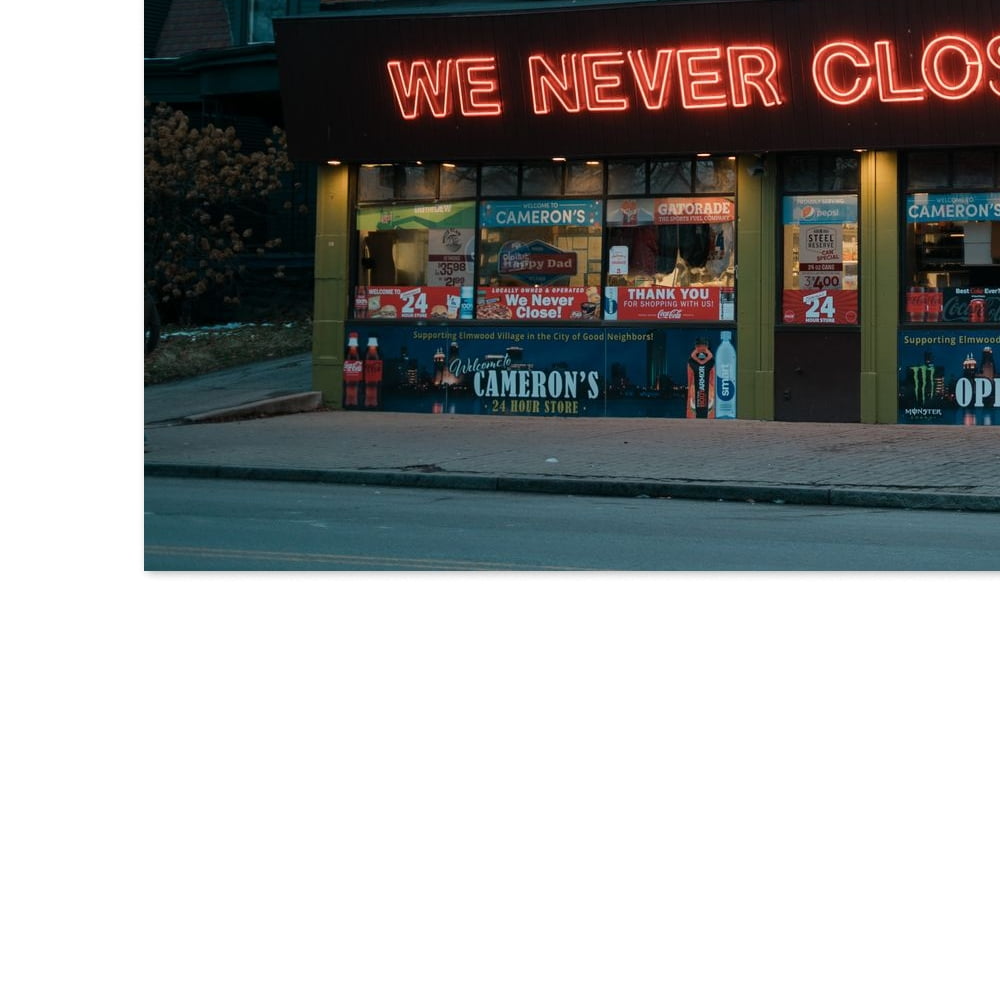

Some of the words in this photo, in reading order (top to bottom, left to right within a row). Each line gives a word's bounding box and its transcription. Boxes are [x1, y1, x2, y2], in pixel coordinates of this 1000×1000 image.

[387, 56, 502, 120] WE
[528, 45, 783, 114] NEVER
[658, 202, 730, 215] GATORADE
[816, 208, 839, 217] pepsi
[495, 209, 586, 225] CAMERON'S
[808, 234, 834, 242] STEEL
[503, 259, 545, 270] Happy
[548, 258, 572, 268] Dad
[628, 288, 676, 299] THANK
[681, 288, 709, 299] YOU
[402, 292, 428, 313] 24
[505, 294, 528, 306] We
[531, 294, 575, 306] Never
[516, 306, 562, 318] Close!
[804, 295, 836, 318] 24
[413, 331, 457, 341] Supporting
[498, 332, 525, 341] Village
[554, 333, 569, 342] City
[607, 333, 654, 342] Neighbors!
[904, 335, 956, 345] Supporting
[959, 335, 1000, 344] Elmwood
[449, 358, 501, 376] Welcome
[502, 353, 511, 367] to
[473, 370, 600, 399] CAMERON'S
[492, 401, 506, 412] 24
[510, 400, 540, 412] HOUR
[544, 400, 579, 414] STORE
[905, 407, 942, 416] MONSTER
